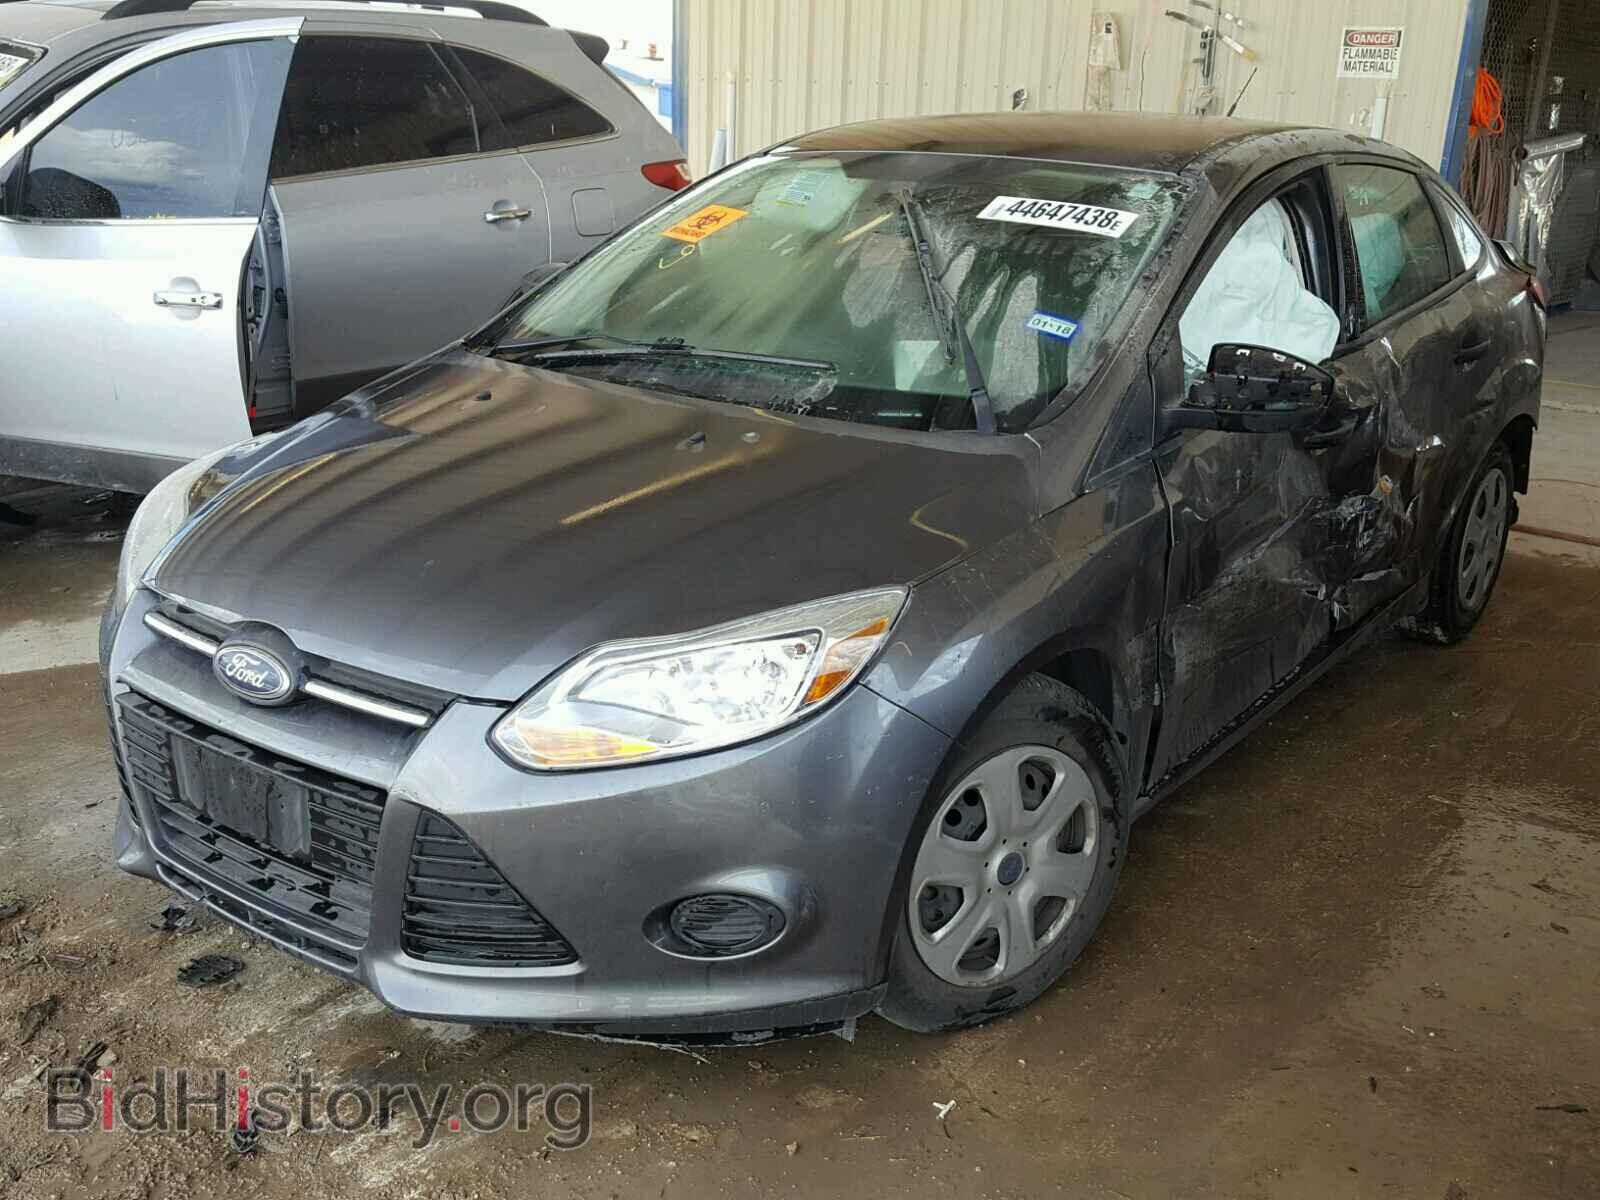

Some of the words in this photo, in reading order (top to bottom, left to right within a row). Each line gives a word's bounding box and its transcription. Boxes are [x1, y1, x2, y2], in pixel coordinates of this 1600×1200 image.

[1352, 33, 1396, 44] DANGER
[1343, 47, 1398, 60] FLAMMABLE
[1343, 60, 1394, 73] MATERIAL
[225, 652, 269, 688] Ford
